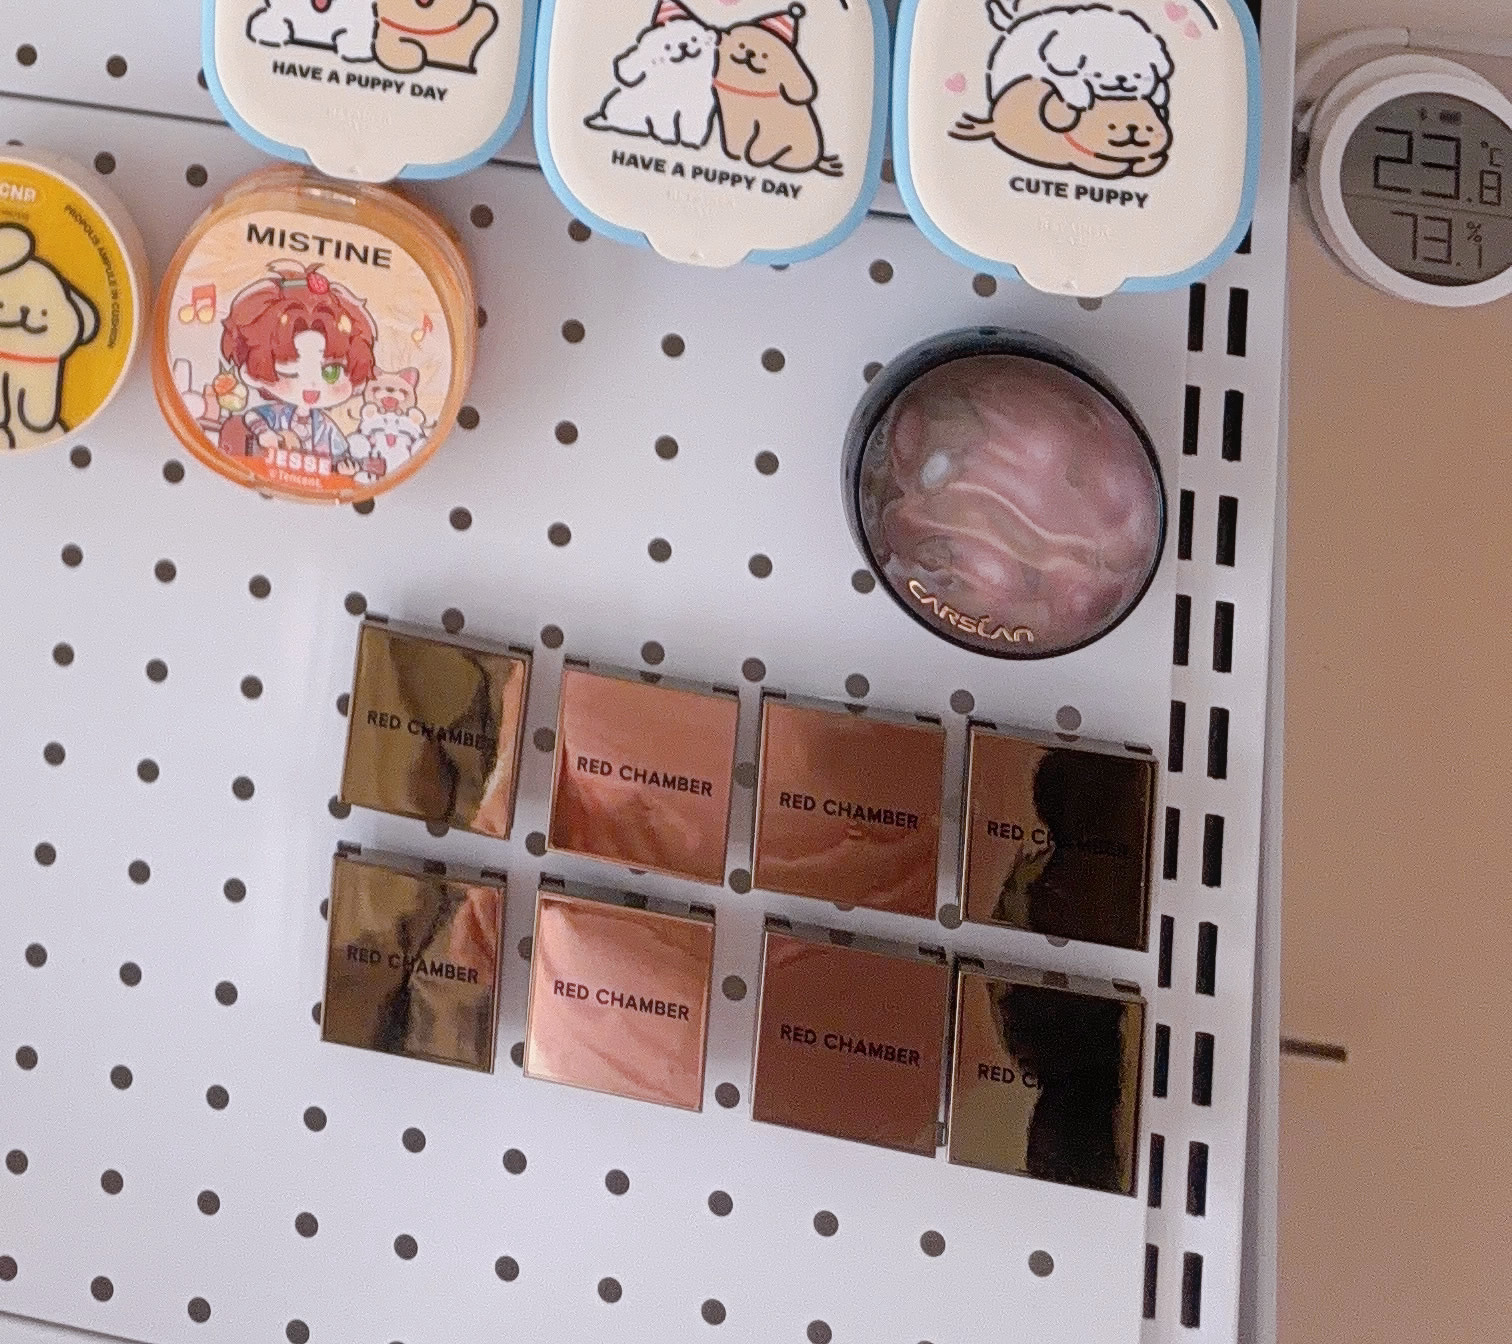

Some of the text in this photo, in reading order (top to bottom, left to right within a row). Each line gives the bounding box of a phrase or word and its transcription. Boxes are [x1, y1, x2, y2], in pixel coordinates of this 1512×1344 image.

[273, 59, 448, 102] HAVE A PUPPY DAY
[612, 150, 803, 199] HAVE A PUPPY DAY
[1009, 175, 1149, 209] CUTE PUPPY
[247, 223, 393, 269] MISTINE
[264, 447, 331, 476] JESSE
[367, 711, 401, 731] RED
[577, 756, 713, 798] RED CHAMBER
[779, 792, 919, 831] RED CHAMBER
[987, 820, 1025, 841] RED
[347, 944, 479, 985] RED CHAMBER
[553, 979, 689, 1022] RED CHAMBER
[780, 1024, 920, 1067] RED CHAMBER
[977, 1063, 1015, 1084] RED
